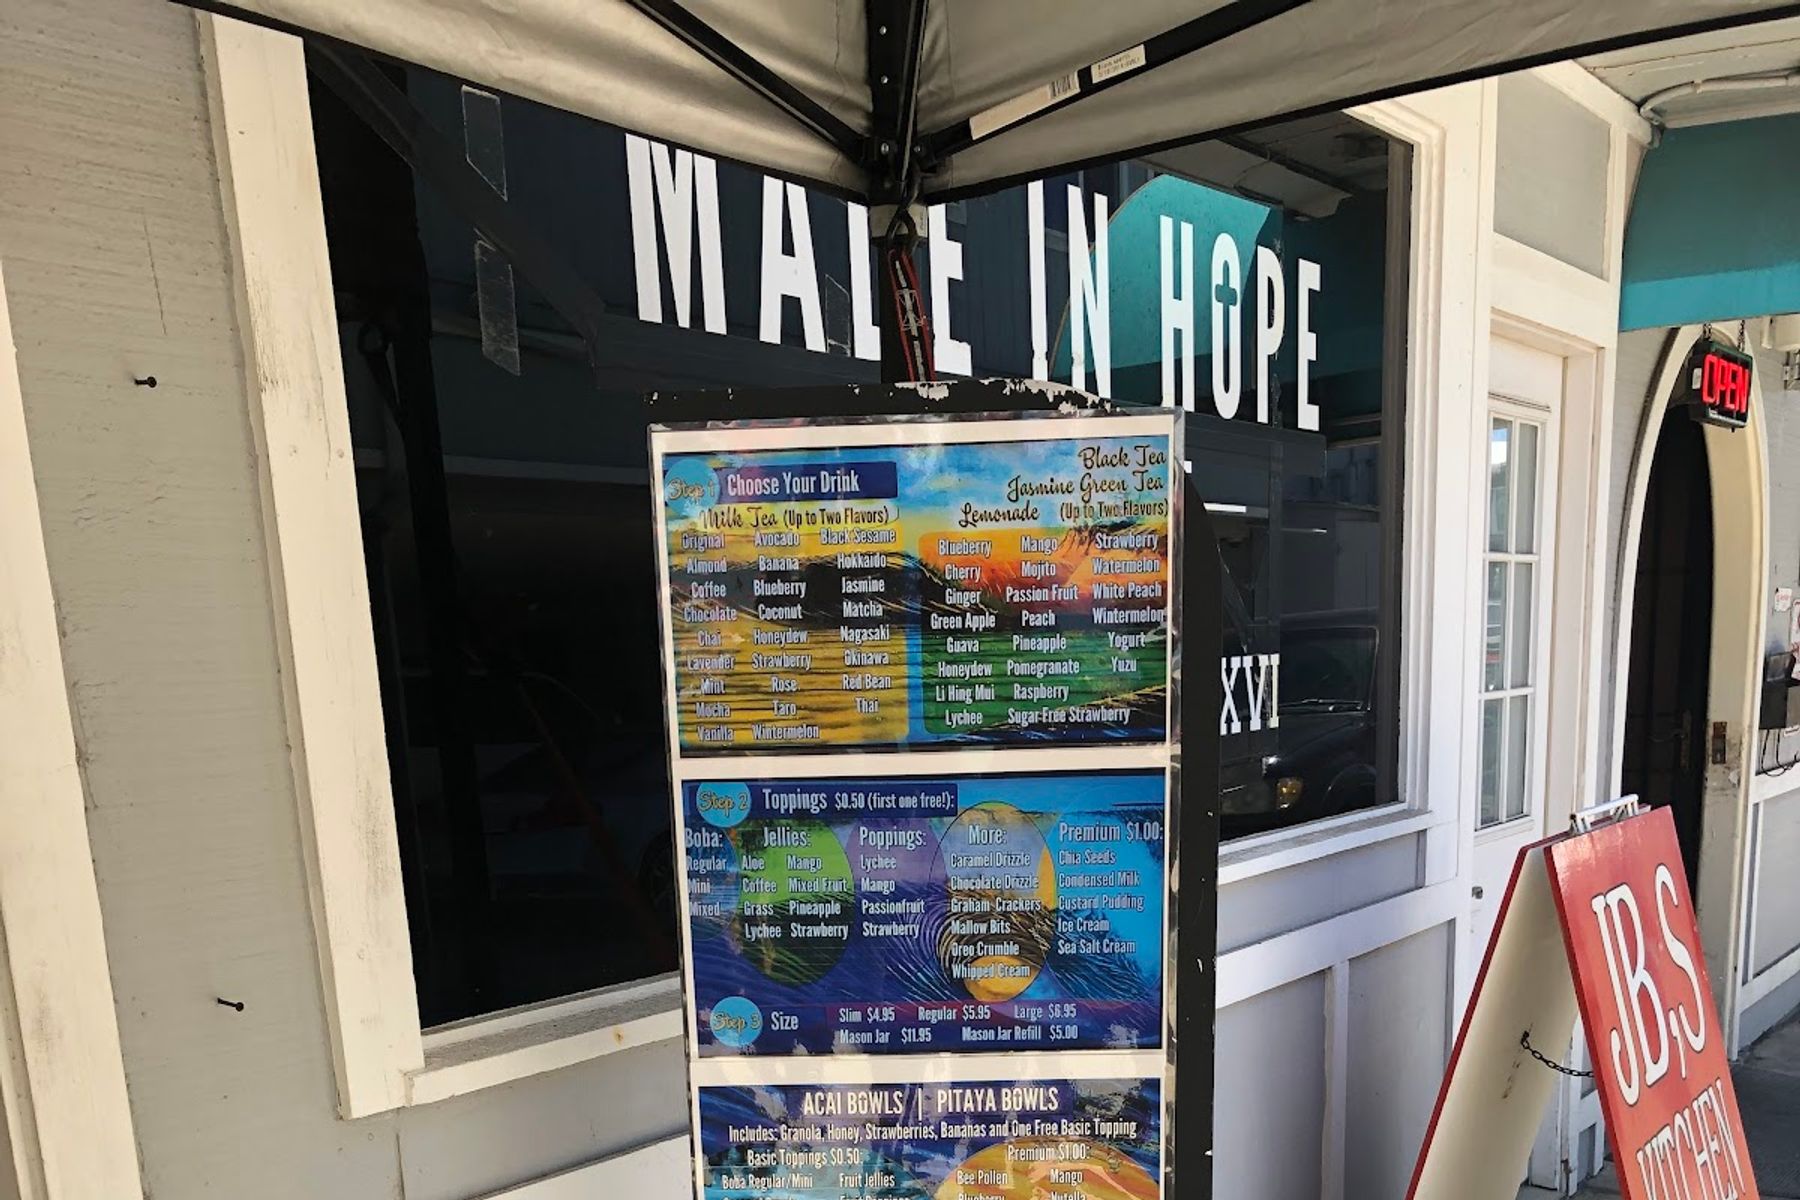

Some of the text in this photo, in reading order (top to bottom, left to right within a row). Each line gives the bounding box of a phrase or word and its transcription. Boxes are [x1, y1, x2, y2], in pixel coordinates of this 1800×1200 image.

[625, 132, 1321, 432] MAE IN HOPE
[1702, 353, 1749, 414] OPEN
[1079, 445, 1166, 470] Black Tea
[728, 470, 859, 496] Choose Your Drink
[1007, 470, 1164, 502] Jasmine Green Tea
[701, 506, 889, 529] Milk Tea (Up to Two Flavors)
[959, 501, 1039, 528] Lemonade
[1060, 505, 1079, 522] (Up
[1083, 503, 1095, 518] to
[1124, 498, 1168, 518] Flavors)
[938, 540, 991, 558] Blueberry
[1021, 536, 1057, 553] Mango
[1095, 533, 1158, 550] Strawberry
[759, 557, 799, 571] Banana
[837, 553, 887, 569] Hokkaido
[1021, 561, 1056, 579] Mojito
[1092, 558, 1160, 574] Watermelon
[945, 564, 981, 582] Cherry
[691, 582, 726, 597] Coffee
[753, 580, 806, 598] Blueberry
[841, 577, 885, 593] Jasmine
[1006, 584, 1079, 602] Passion Fruit
[1092, 582, 1162, 599] White Peach
[945, 589, 981, 607] Ginger
[758, 604, 802, 620] Coconut
[843, 602, 883, 617] Matcha
[1022, 610, 1056, 626] Peach
[1092, 606, 1165, 624] Wintermelon
[931, 612, 995, 630] Green Apple
[840, 625, 889, 644] Nagasaki
[1108, 632, 1146, 650] Yogurt
[947, 637, 980, 653] Guava
[1013, 634, 1067, 654] Pineapple
[752, 653, 811, 670] Strawberry
[938, 661, 992, 680] Honeydew
[1007, 659, 1079, 678] Pomegranate
[1111, 657, 1136, 672] Yuzu
[936, 684, 995, 703] Li Hing Mui
[1014, 684, 1069, 703] Raspberry
[945, 710, 983, 728] Lychee
[1069, 707, 1130, 724] Strawberry
[698, 791, 748, 817] Step 2
[762, 788, 954, 814] Toppings $0.50 (first one free!):
[685, 828, 722, 847] Boba:
[763, 827, 811, 847] Jellies:
[859, 826, 926, 850] Poppings:
[969, 824, 1007, 845] More:
[1059, 822, 1163, 842] Premium $1.00:
[861, 854, 896, 872] Lychee
[743, 877, 777, 893] Coffee
[861, 877, 895, 894] Mango
[789, 900, 841, 917] Pineapple
[862, 899, 925, 915] Passionfruit
[745, 923, 781, 940] Lychee
[790, 922, 848, 940] Strawberry
[863, 922, 919, 939] Strawberry
[1058, 917, 1109, 932] Ice Cream
[1058, 939, 1136, 954] Sea Salt Cream
[771, 1012, 798, 1030] Size
[839, 1008, 862, 1022] Slim
[867, 1007, 895, 1023] $4.95
[918, 1007, 957, 1023] Regular
[962, 1005, 990, 1021] $5.95
[1014, 1005, 1043, 1021] Large
[839, 1025, 1078, 1044] Mason Jar $11.95 Mason Jar Refill $5.00
[804, 1087, 1059, 1115] ACAI BOWLS PITAYA BOWLS
[729, 1118, 1136, 1144] Includes: Granola, Honey, Strawberries, Bananas and One Free Basic Topping
[748, 1150, 777, 1166] Basic
[779, 1149, 827, 1168] Toppings
[957, 1169, 1007, 1184] Bee Pollen
[1050, 1169, 1083, 1185] Mango
